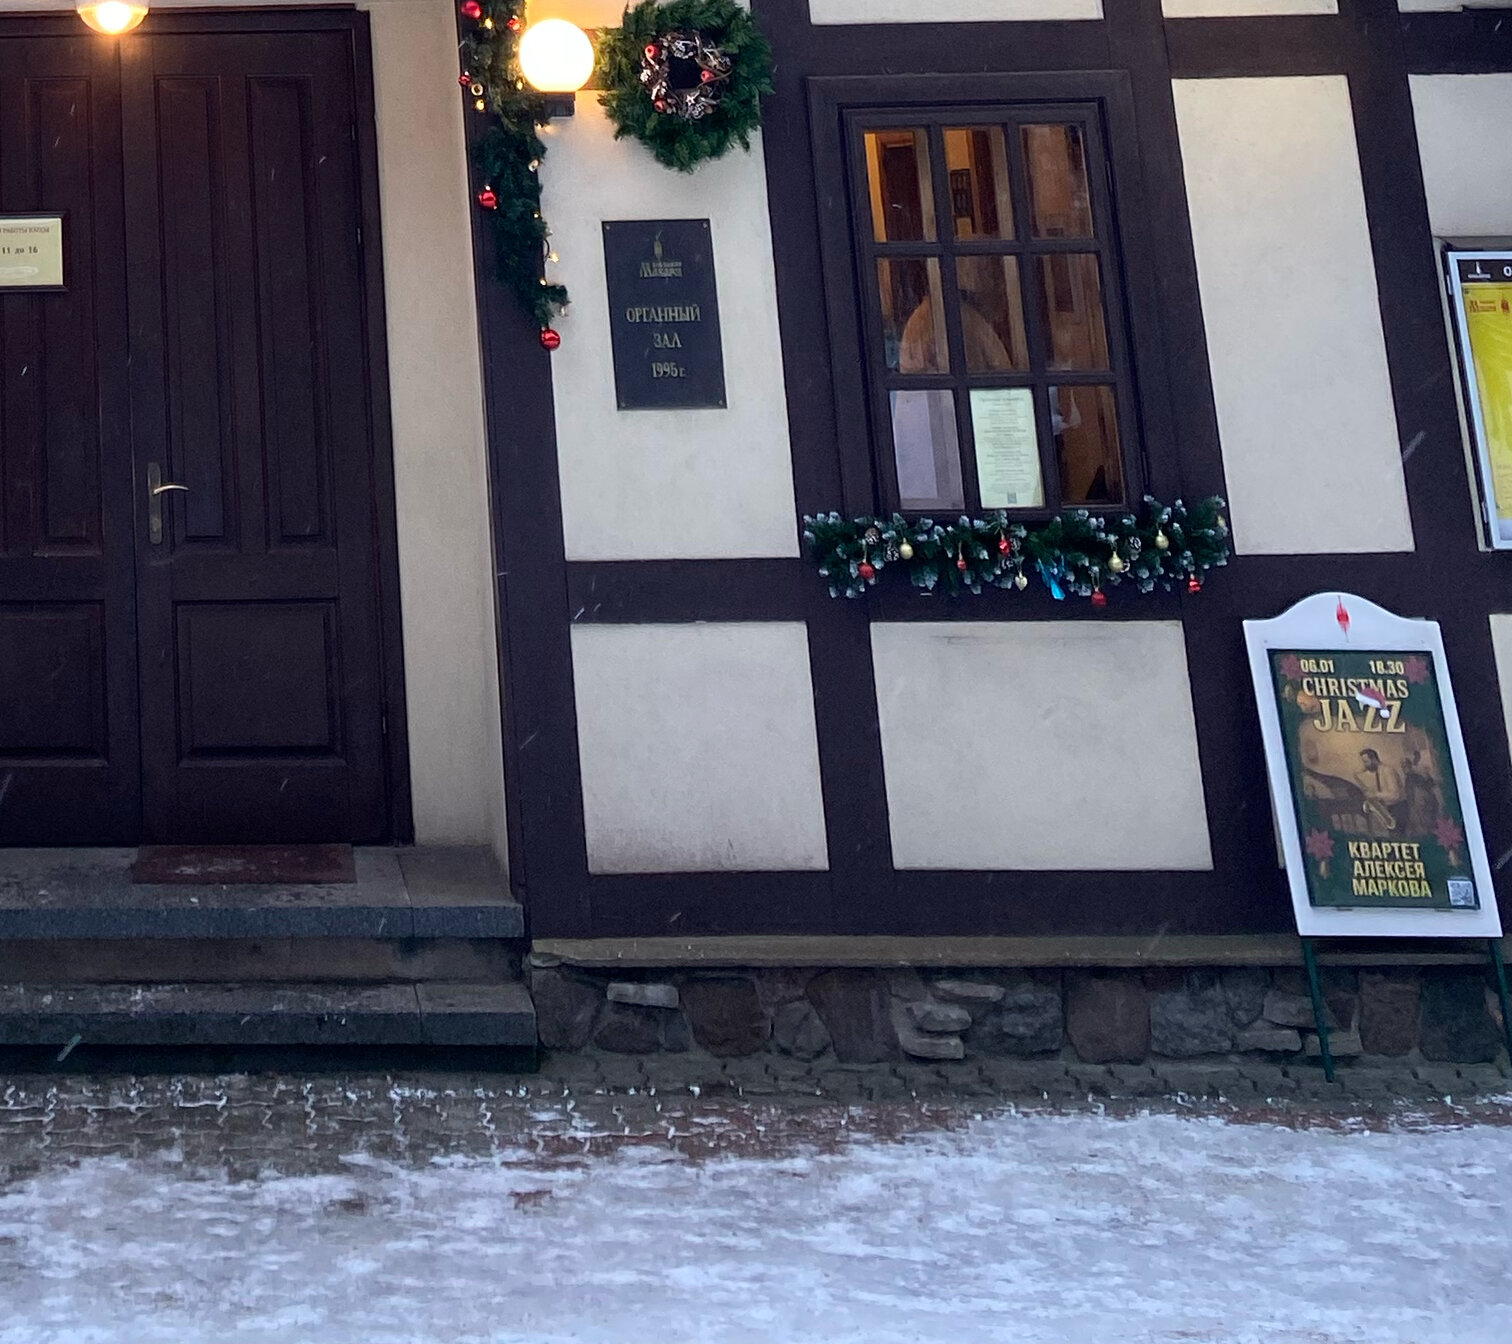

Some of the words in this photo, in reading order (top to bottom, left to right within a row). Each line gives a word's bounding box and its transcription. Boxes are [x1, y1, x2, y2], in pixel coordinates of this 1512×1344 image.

[2, 246, 11, 254] 11
[626, 304, 702, 323] ОРГАННЫЙ
[653, 332, 683, 348] ЗАЛ
[1369, 660, 1405, 675] 18.30
[1302, 676, 1409, 698] CHRISTMAS
[1313, 699, 1406, 733] JAZZ
[1348, 841, 1420, 860] КВАРТЕТ
[1353, 860, 1426, 879] АЛЕКСЕЯ
[1352, 879, 1433, 898] МАРКОВА
